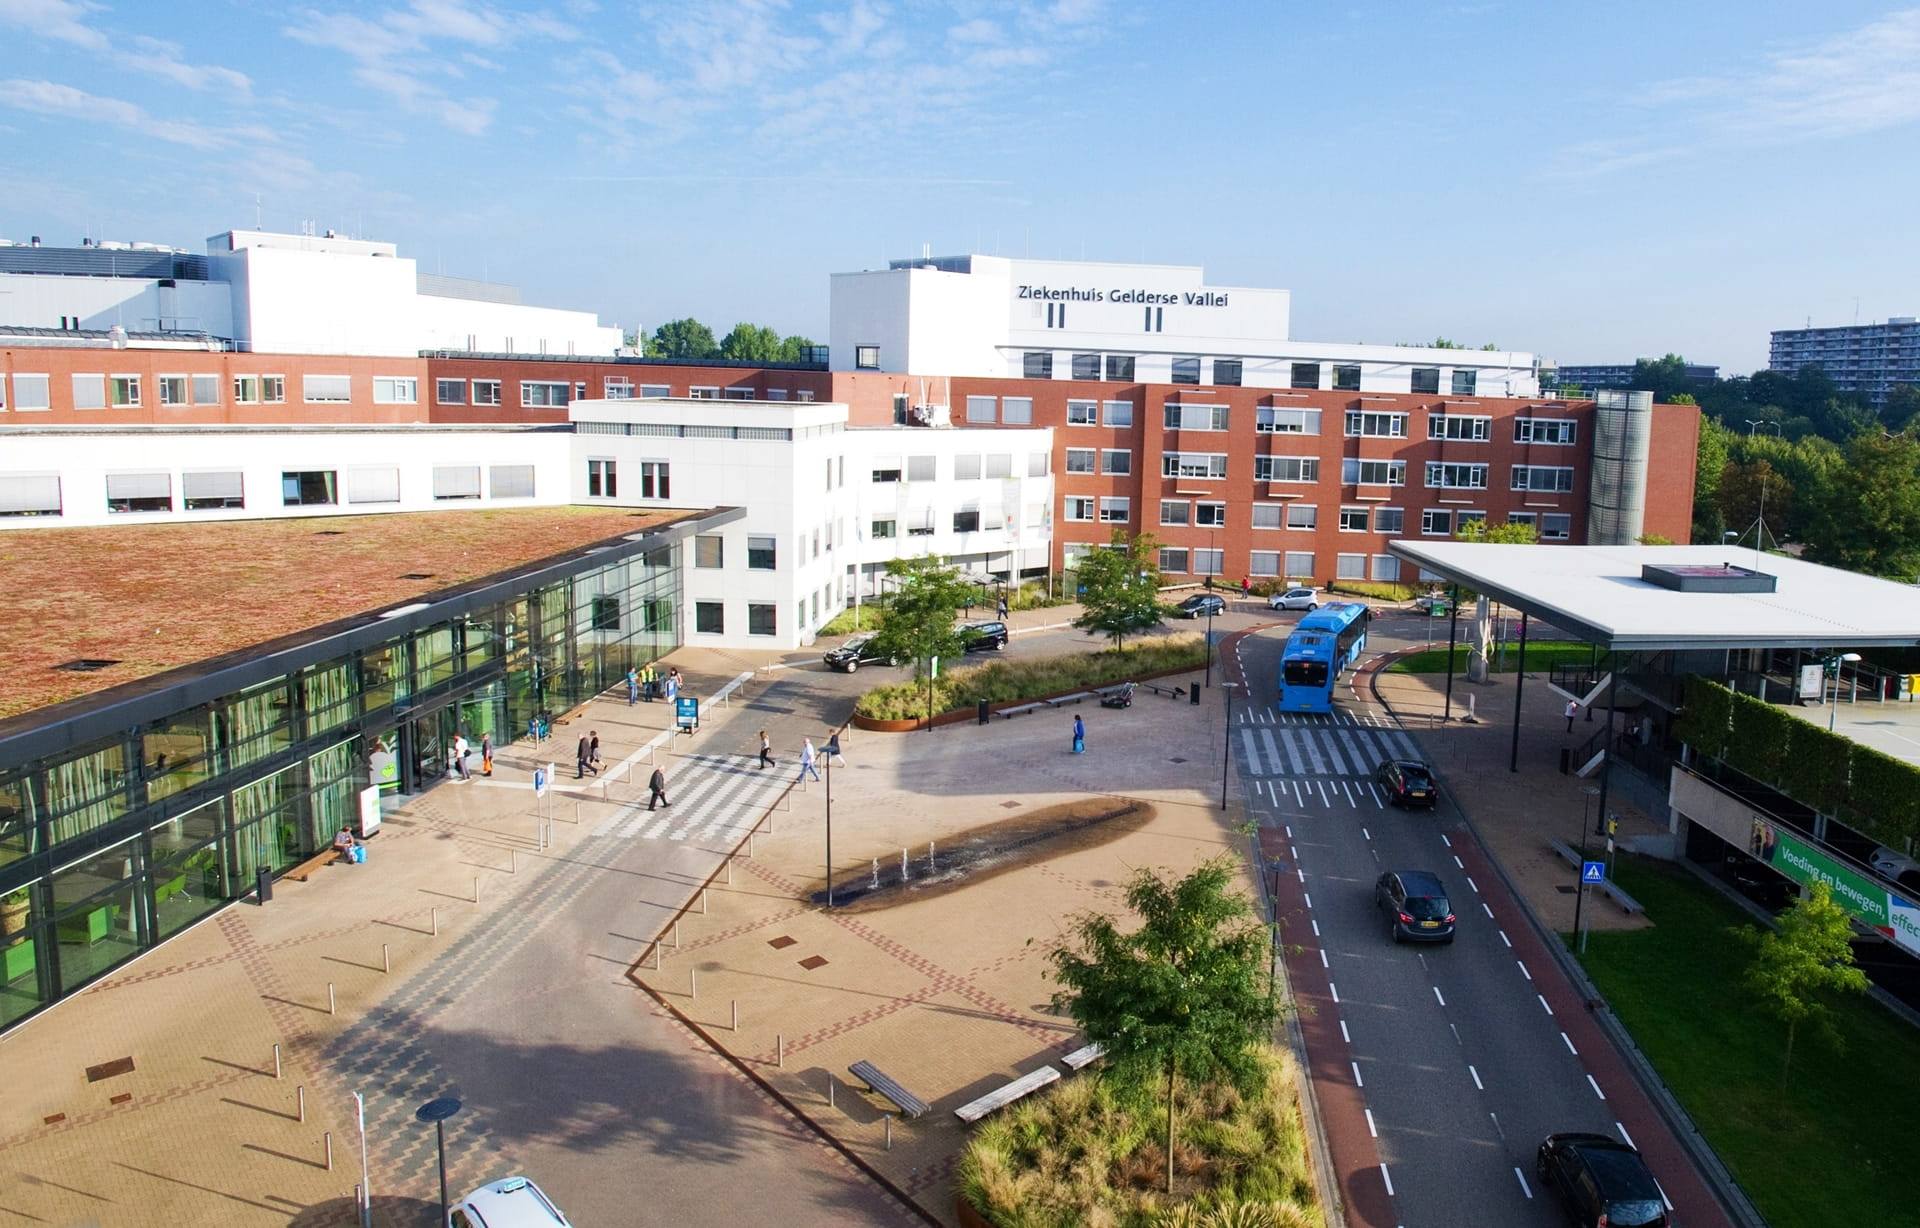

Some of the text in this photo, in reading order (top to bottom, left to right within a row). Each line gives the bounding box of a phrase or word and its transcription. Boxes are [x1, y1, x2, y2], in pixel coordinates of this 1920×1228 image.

[1018, 285, 1229, 307] Ziekenhuis Gelderse Vallei
[1782, 846, 1886, 920] Voeding en bewegen,
